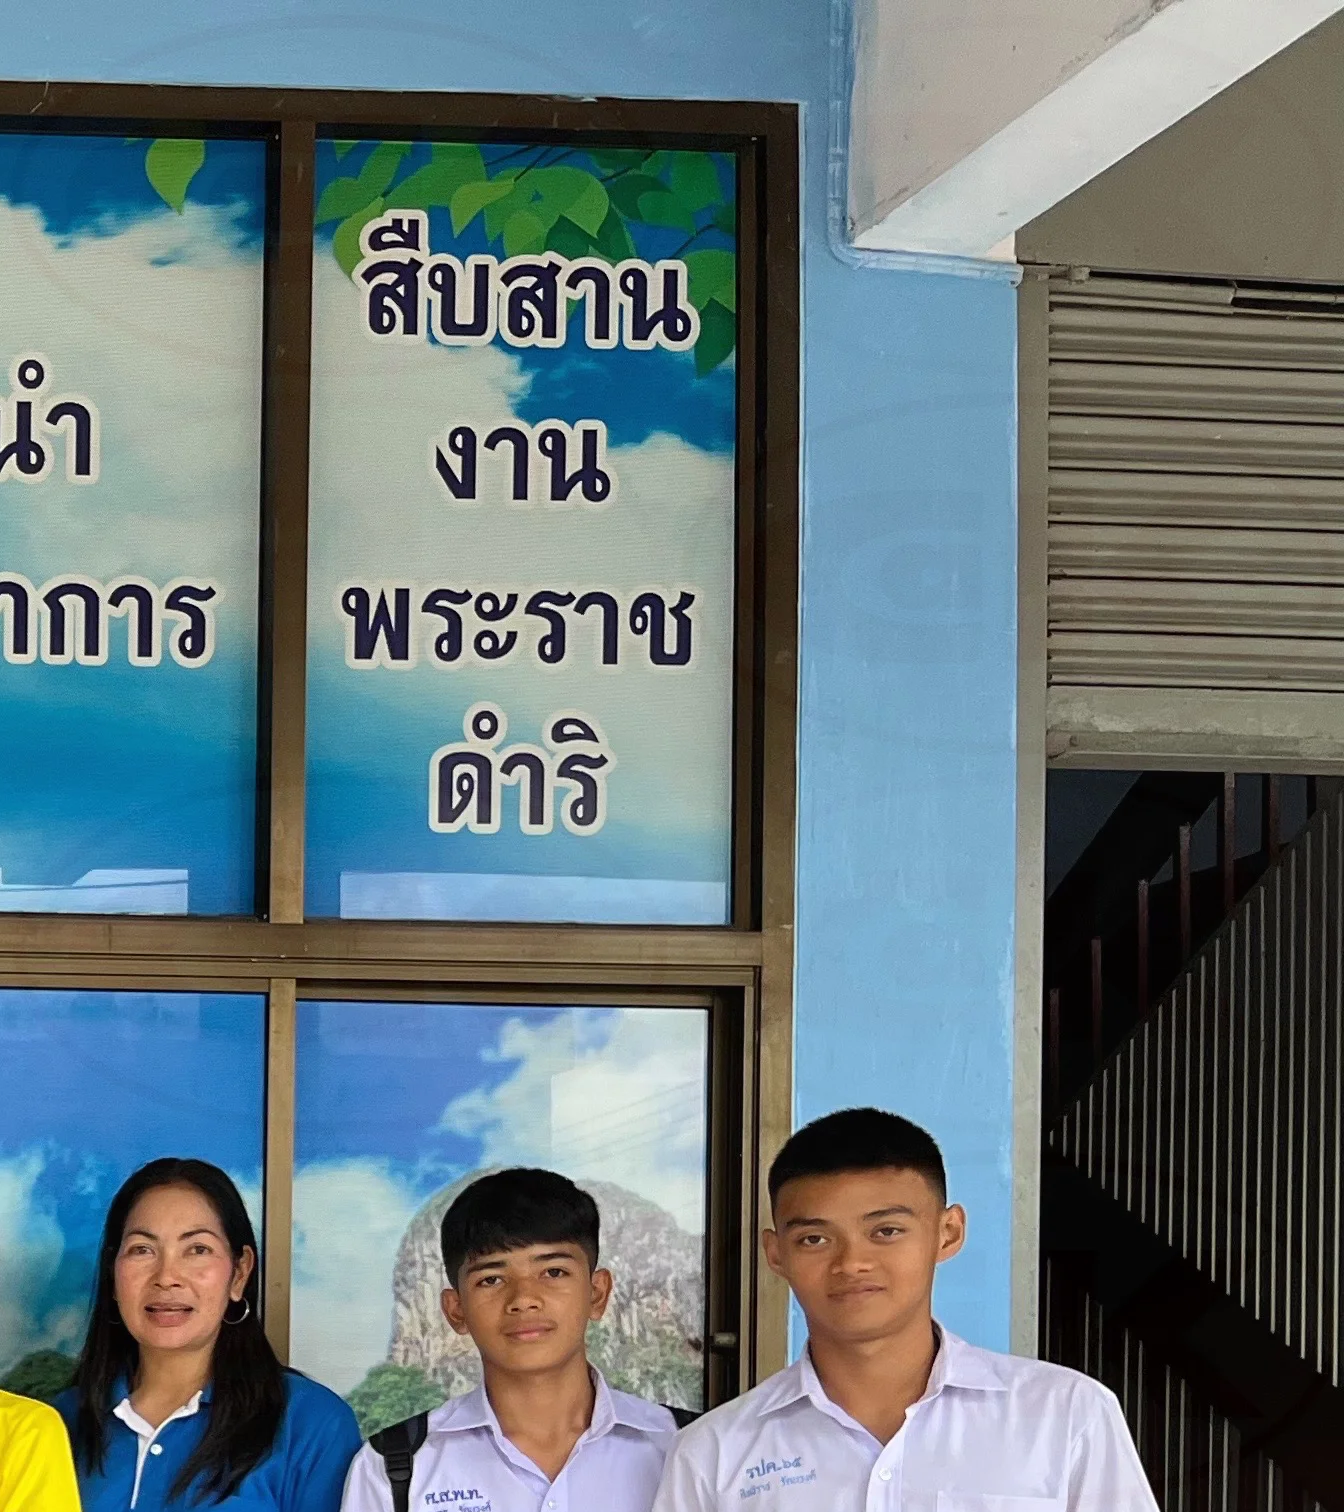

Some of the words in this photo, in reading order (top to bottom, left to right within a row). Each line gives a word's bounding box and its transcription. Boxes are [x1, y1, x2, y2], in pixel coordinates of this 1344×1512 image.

[360, 219, 692, 342] สืบสาน
[436, 427, 610, 502] งาน
[342, 588, 694, 665] พระราช
[439, 711, 607, 825] ดำริ
